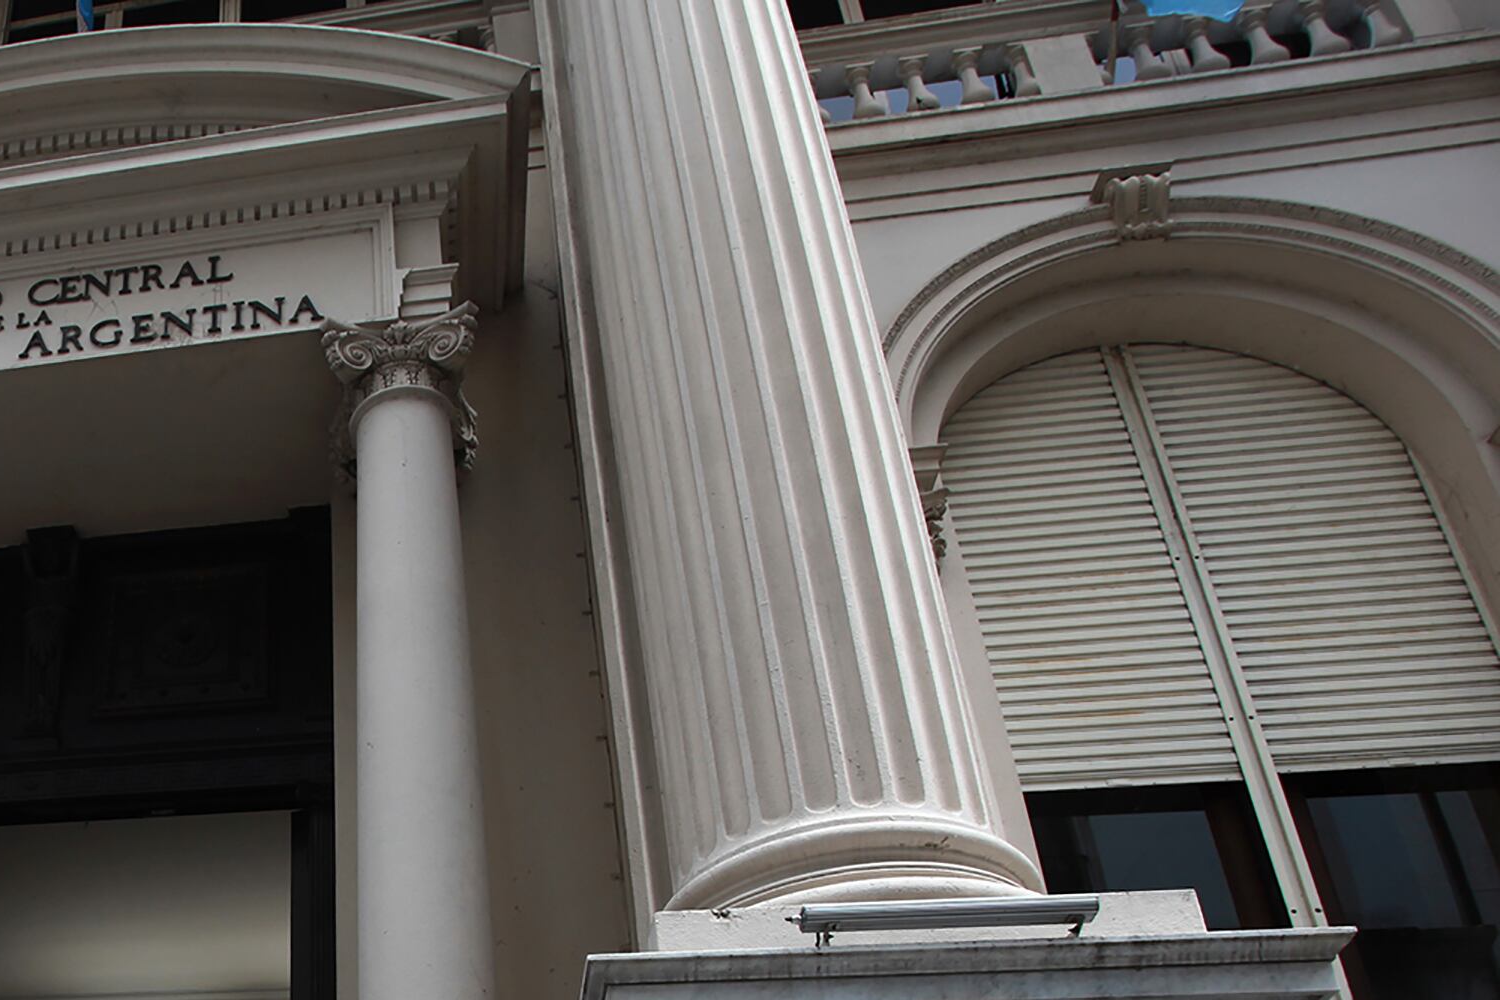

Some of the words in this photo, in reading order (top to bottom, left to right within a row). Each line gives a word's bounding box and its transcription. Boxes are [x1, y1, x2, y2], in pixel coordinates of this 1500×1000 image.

[27, 256, 234, 306] CENTRAL
[16, 310, 52, 330] LA
[18, 295, 325, 360] ARGENTINA
